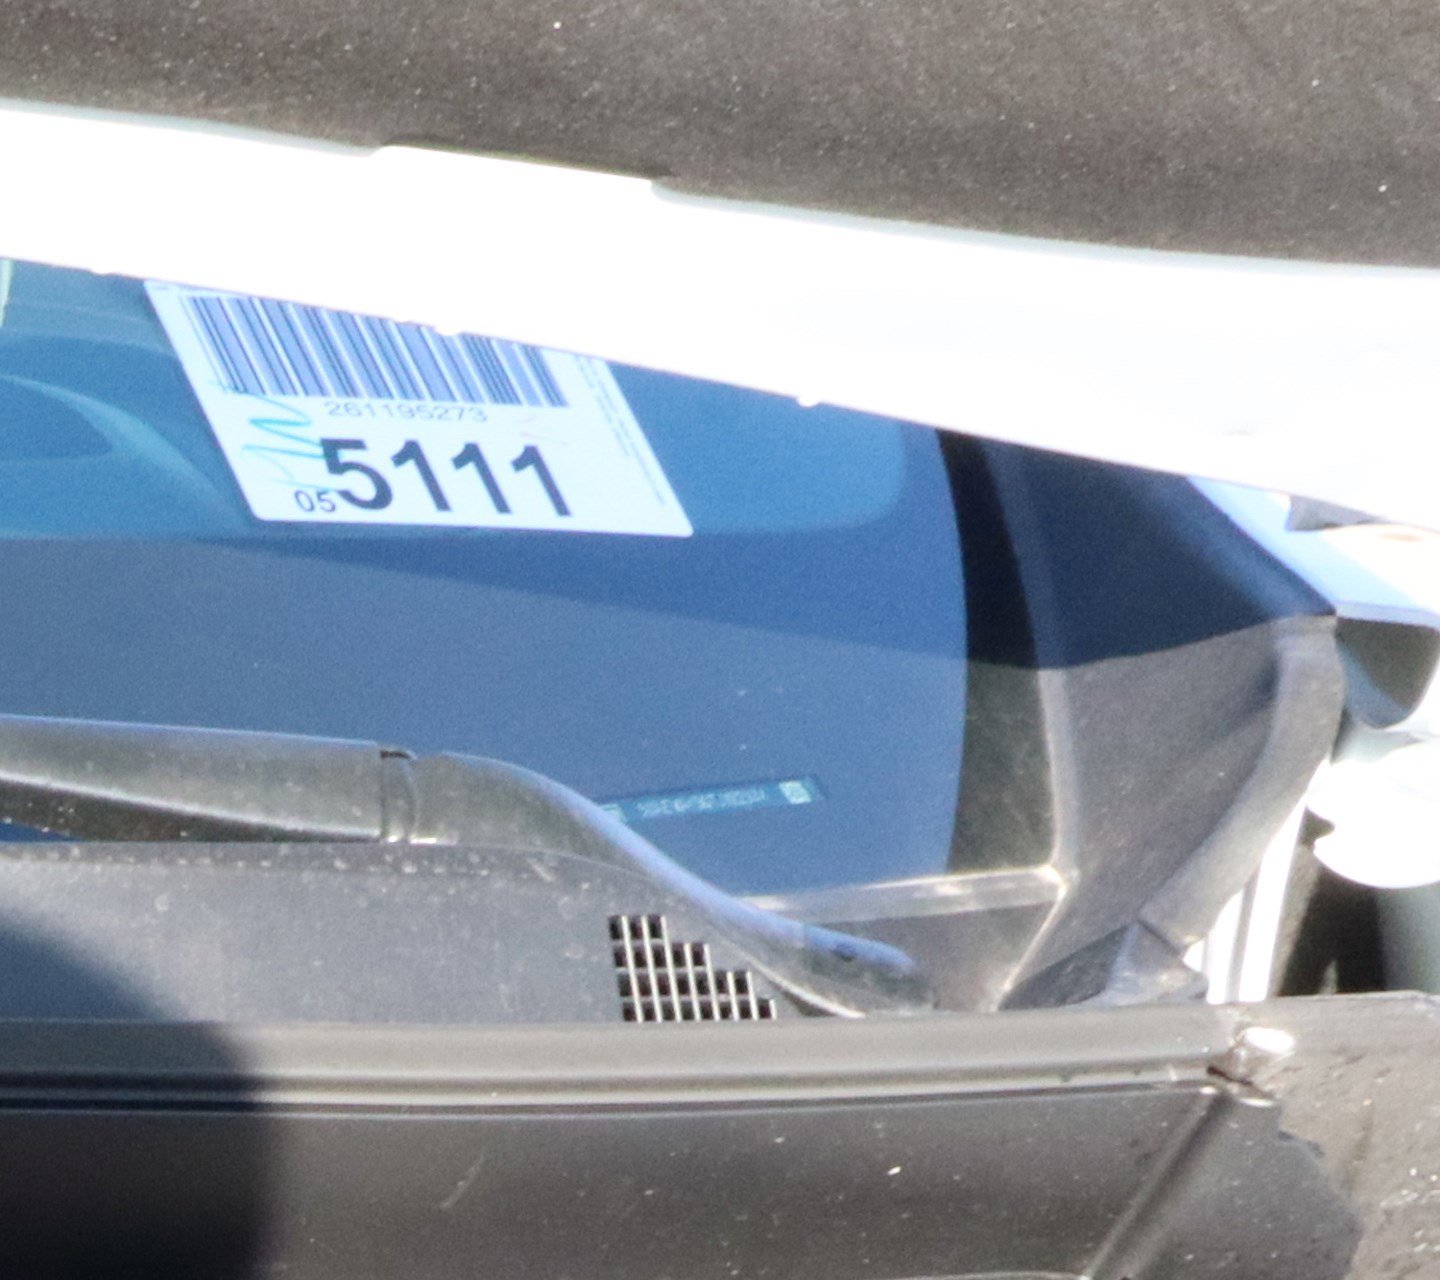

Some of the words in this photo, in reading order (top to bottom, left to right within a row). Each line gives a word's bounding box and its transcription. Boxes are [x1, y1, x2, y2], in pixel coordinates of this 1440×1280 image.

[328, 401, 488, 423] 261195273
[295, 490, 337, 512] 05
[320, 438, 572, 516] 5111
